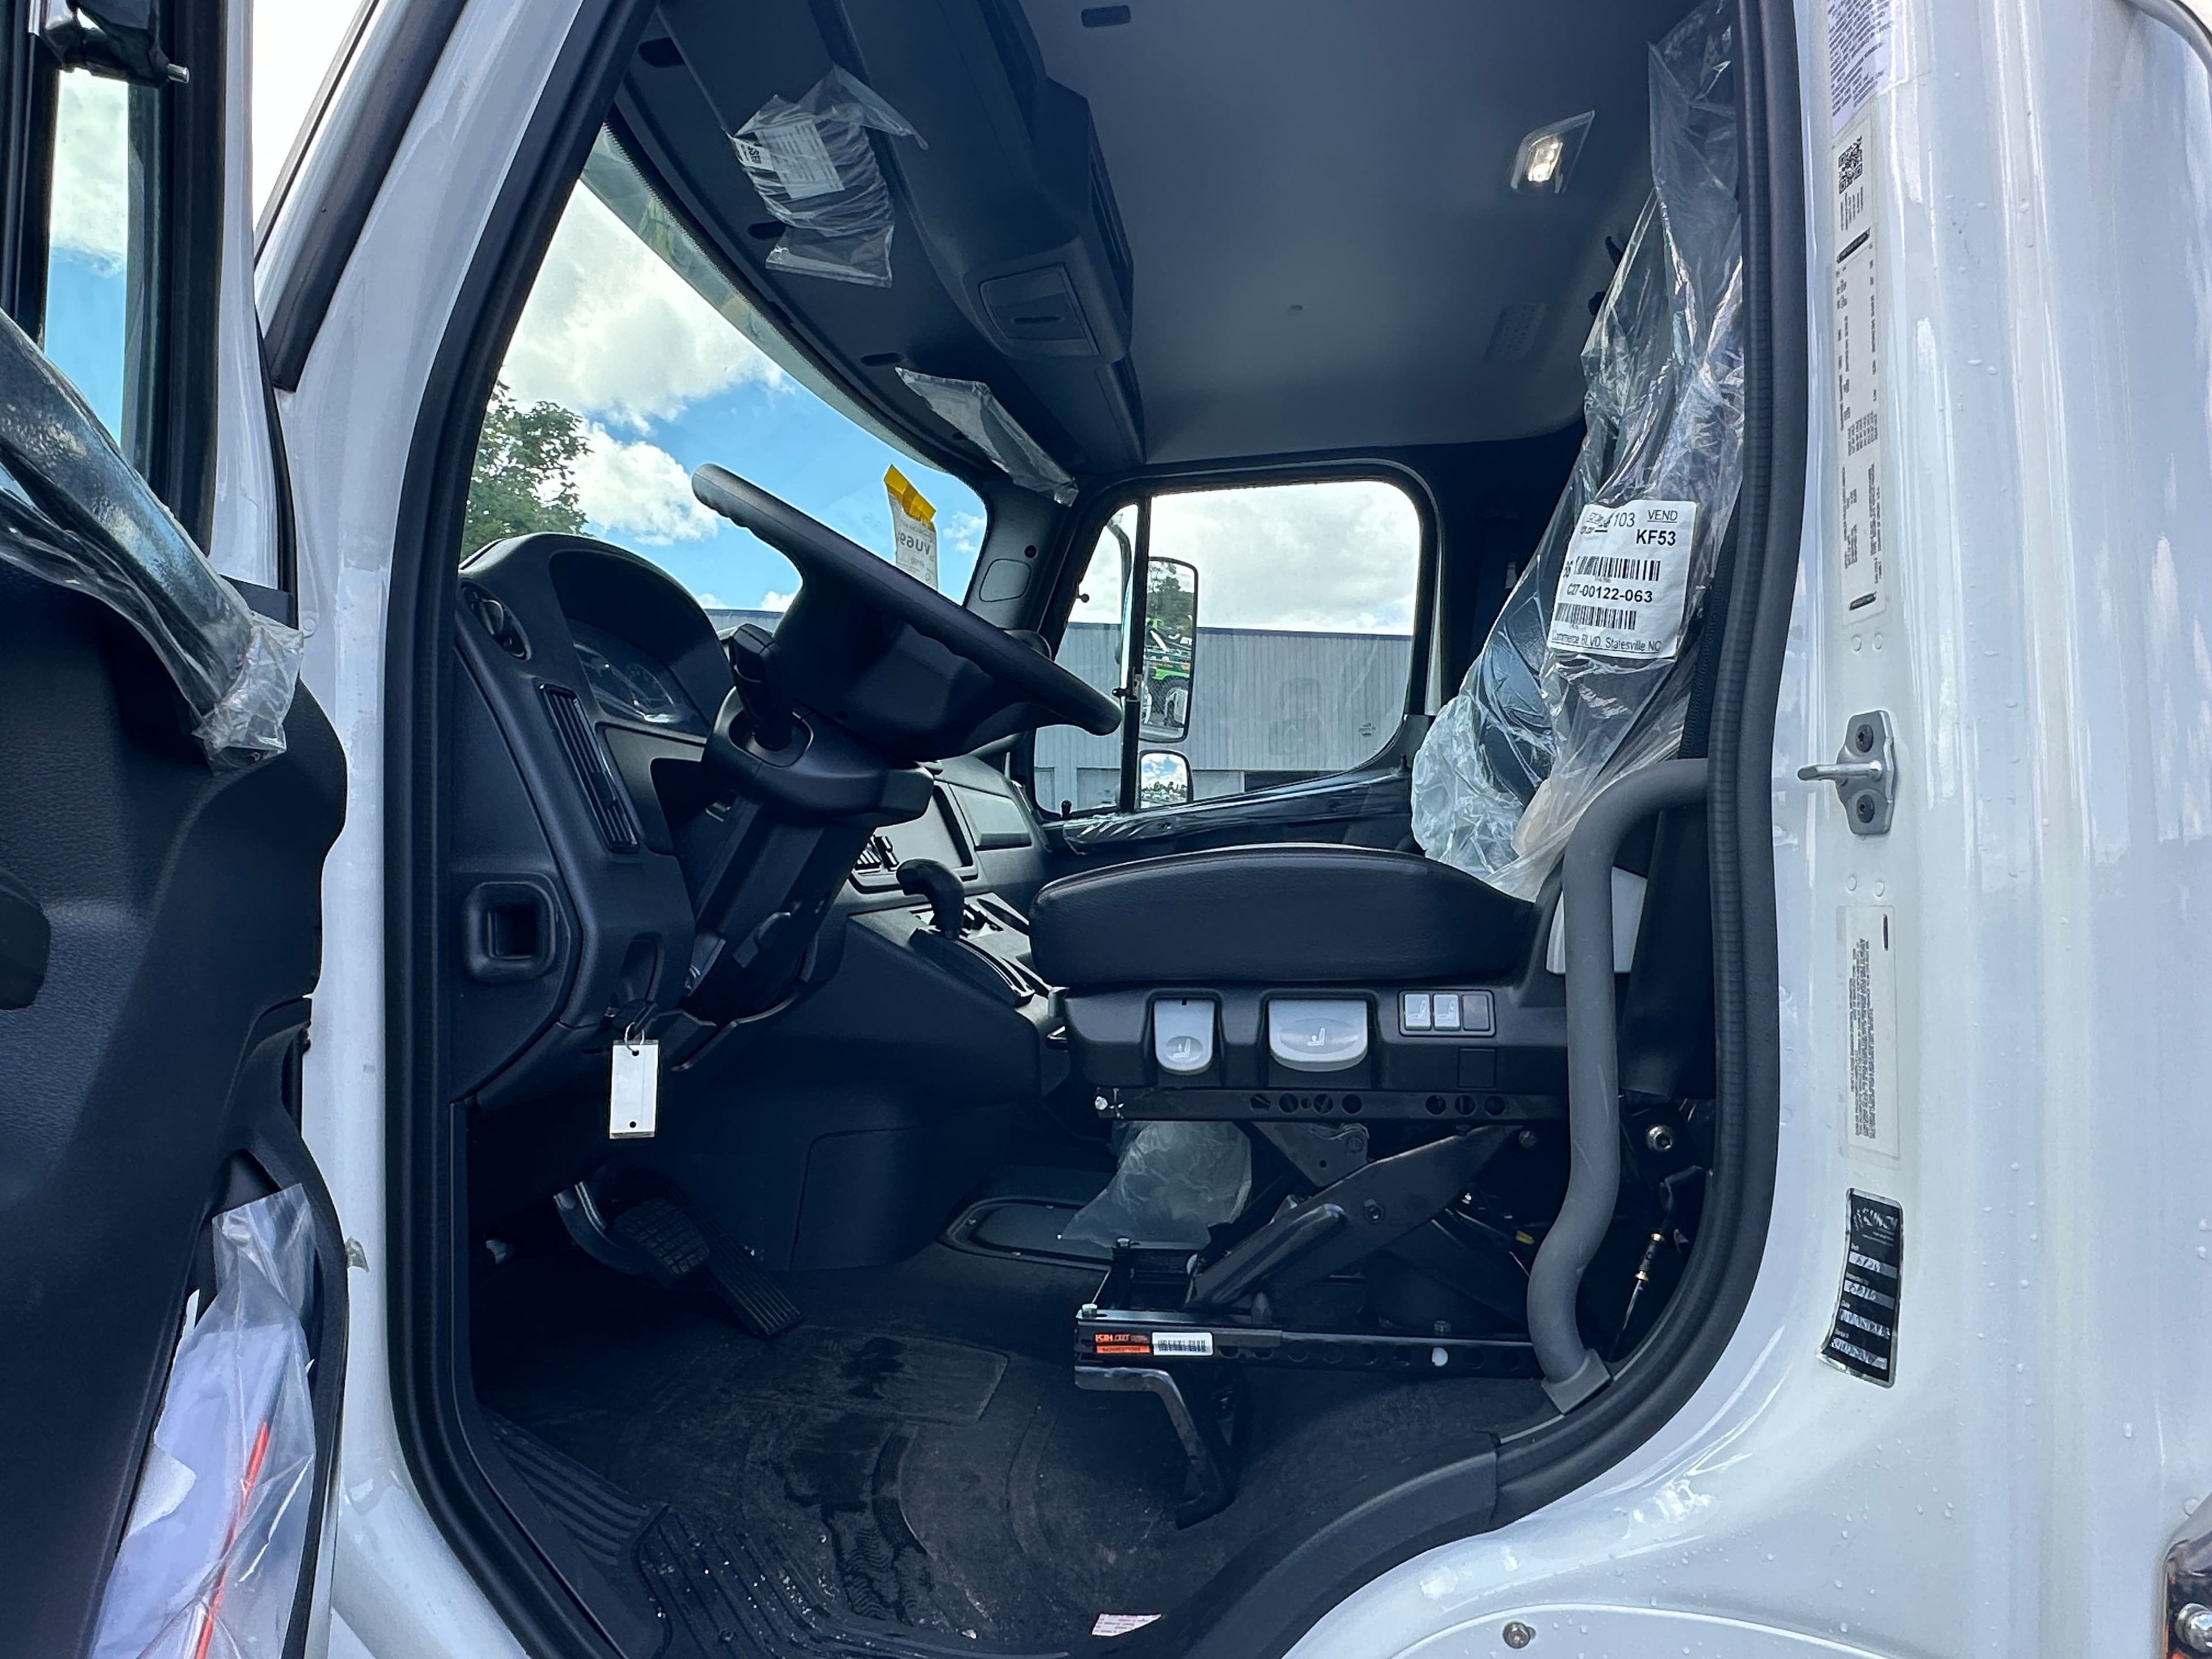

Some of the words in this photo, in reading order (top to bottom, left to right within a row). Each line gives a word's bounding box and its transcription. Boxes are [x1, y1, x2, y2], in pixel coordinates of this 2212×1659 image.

[1647, 509, 1677, 521] VEND
[1636, 529, 1676, 546] KF53
[1648, 641, 1662, 652] NC
